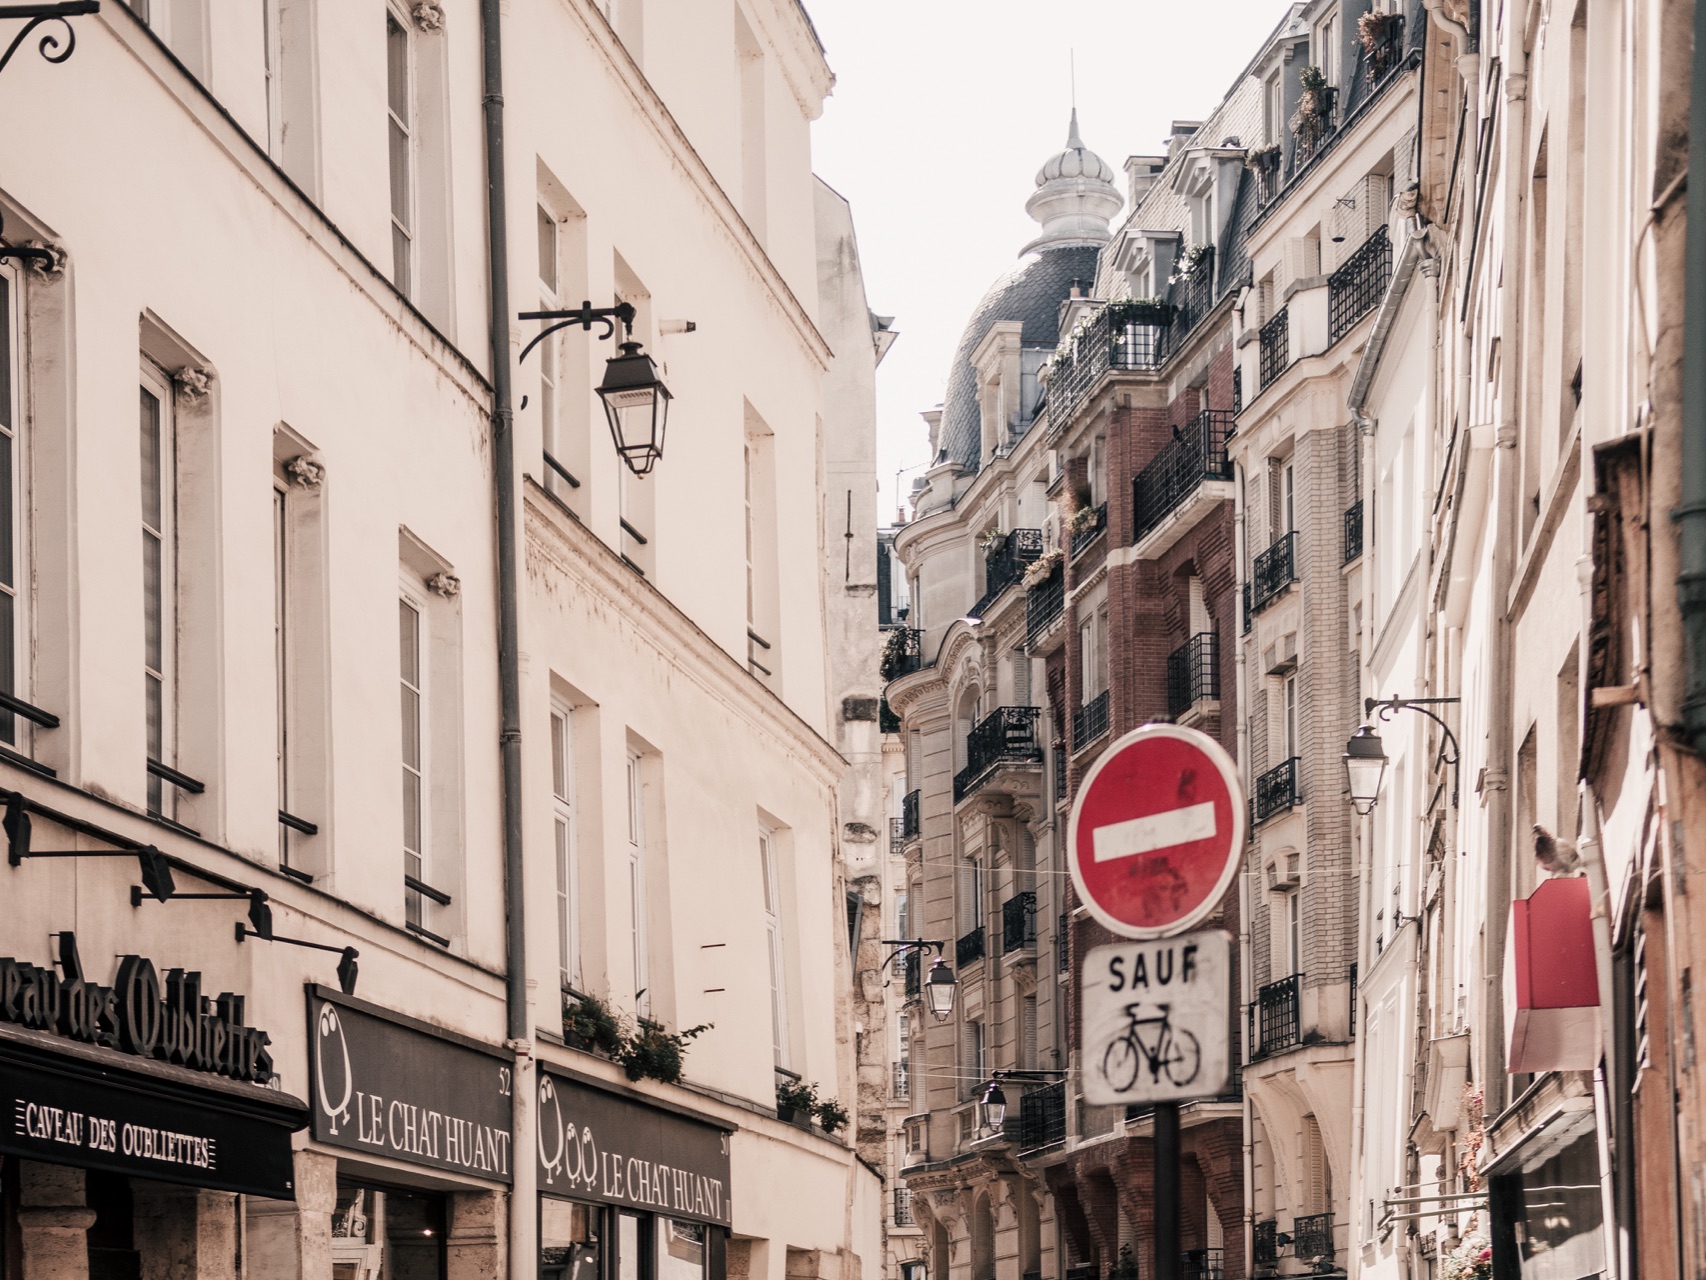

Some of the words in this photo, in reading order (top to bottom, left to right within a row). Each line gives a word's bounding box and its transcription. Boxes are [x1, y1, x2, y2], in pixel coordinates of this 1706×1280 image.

[0, 957, 60, 1034] eau
[58, 931, 120, 1052] des
[1109, 944, 1198, 991] SAUF
[499, 1066, 511, 1097] 52
[26, 1103, 84, 1146] CAVEAU
[89, 1116, 116, 1153] DES
[122, 1123, 209, 1168] OUBLIETTES
[356, 1091, 385, 1146] LE
[388, 1100, 442, 1159] CHAT
[443, 1114, 510, 1175] HUANT
[601, 1151, 624, 1199] LE
[627, 1157, 671, 1210] CHAT
[672, 1168, 722, 1220] HUANT
